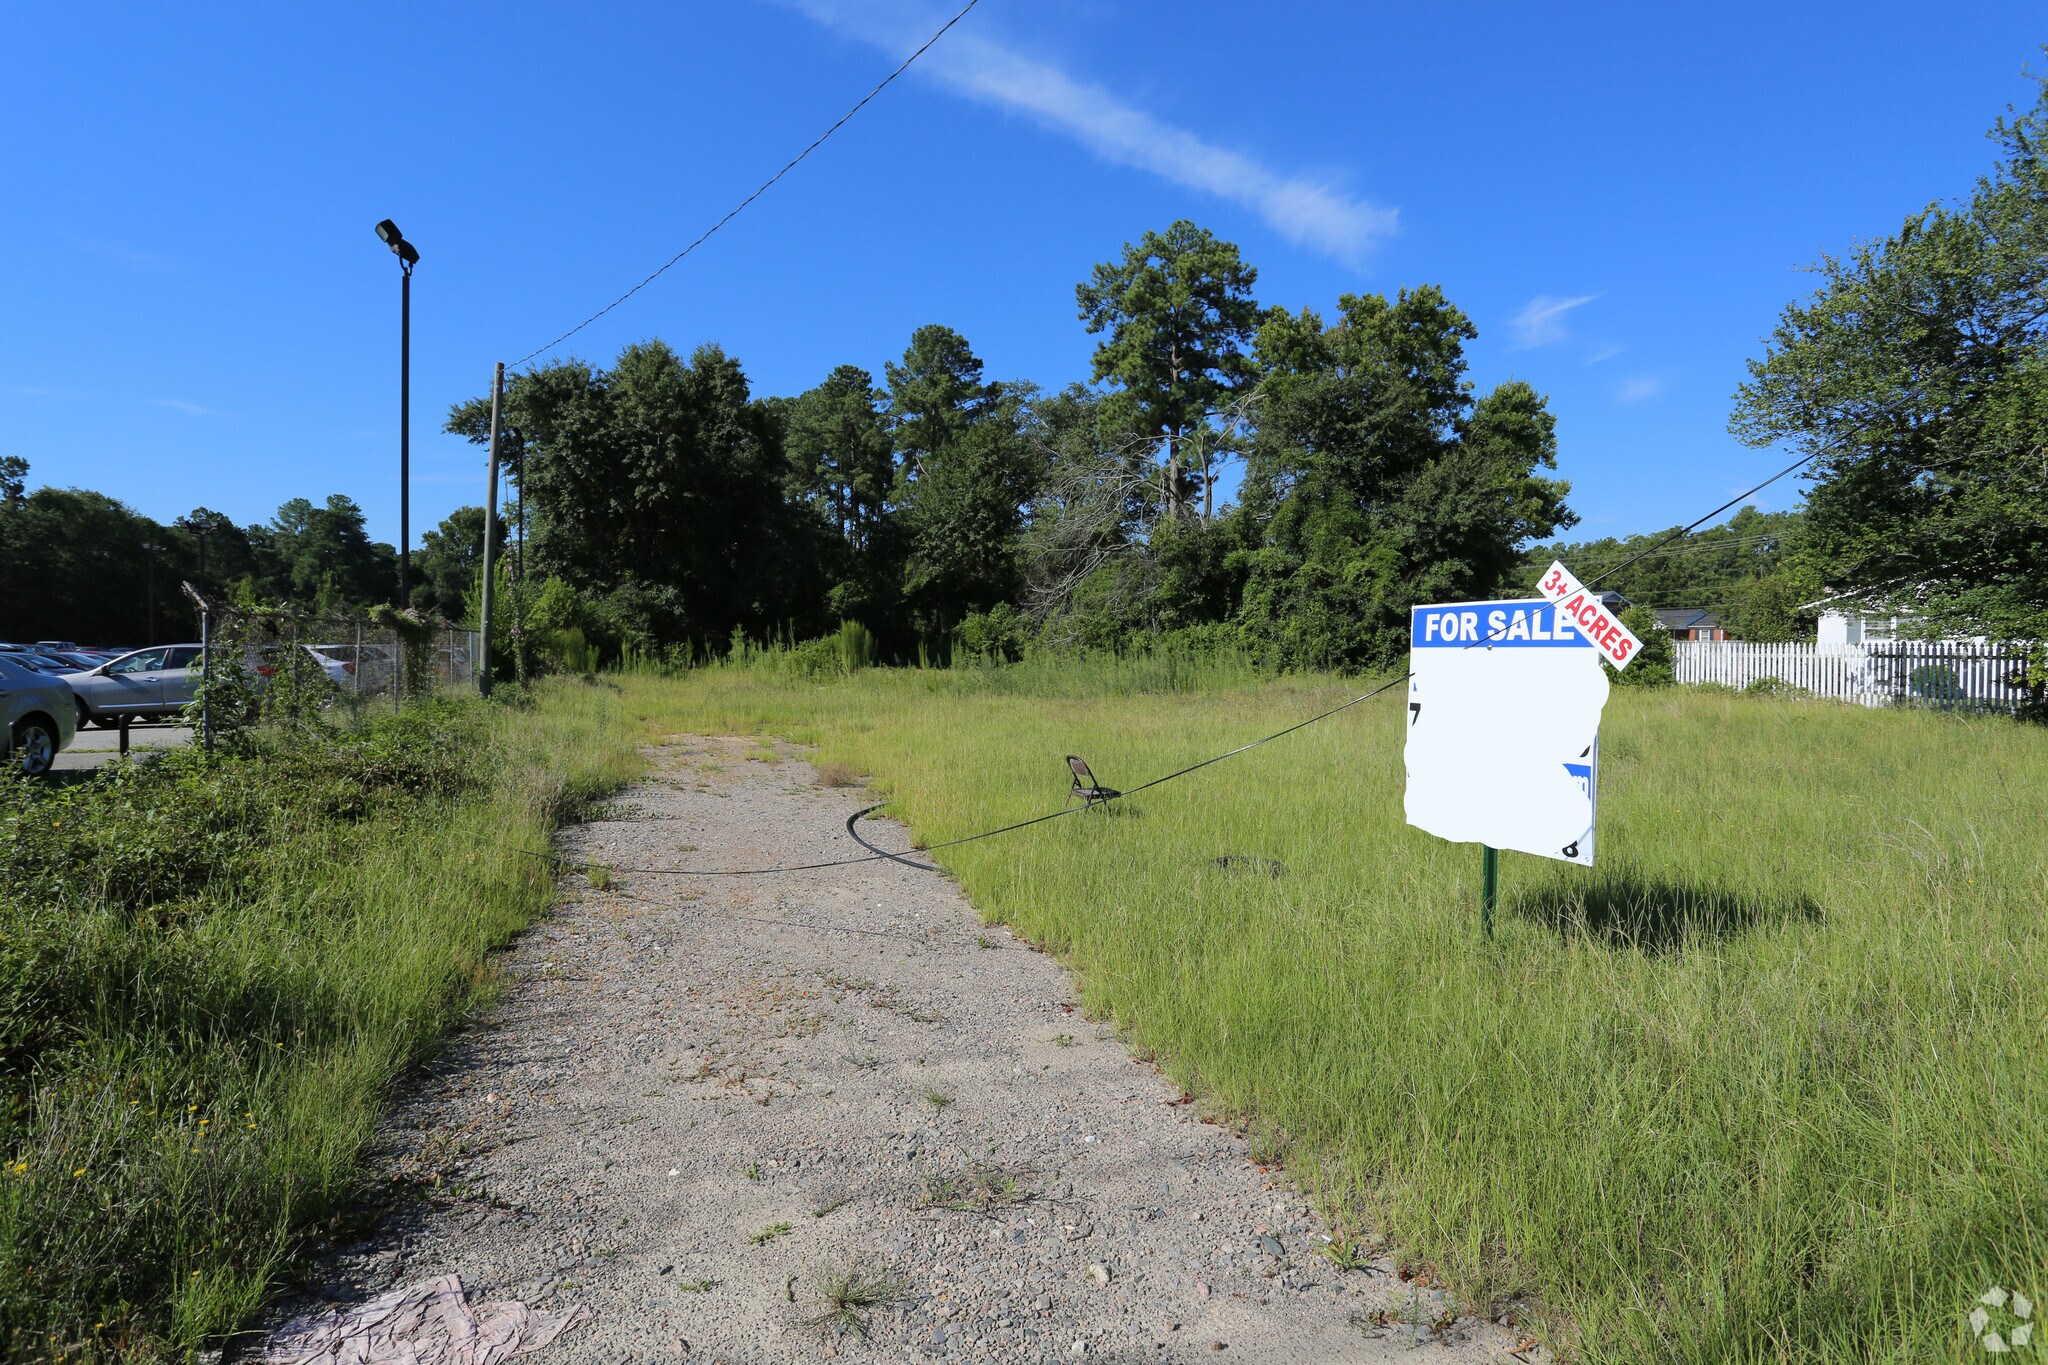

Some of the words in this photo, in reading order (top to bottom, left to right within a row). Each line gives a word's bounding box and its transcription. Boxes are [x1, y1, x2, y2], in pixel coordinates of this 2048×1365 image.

[1425, 612, 1478, 641] FOR
[1487, 609, 1575, 641] SALE
[1544, 570, 1567, 596] 3+
[1565, 594, 1633, 661] ACRES
